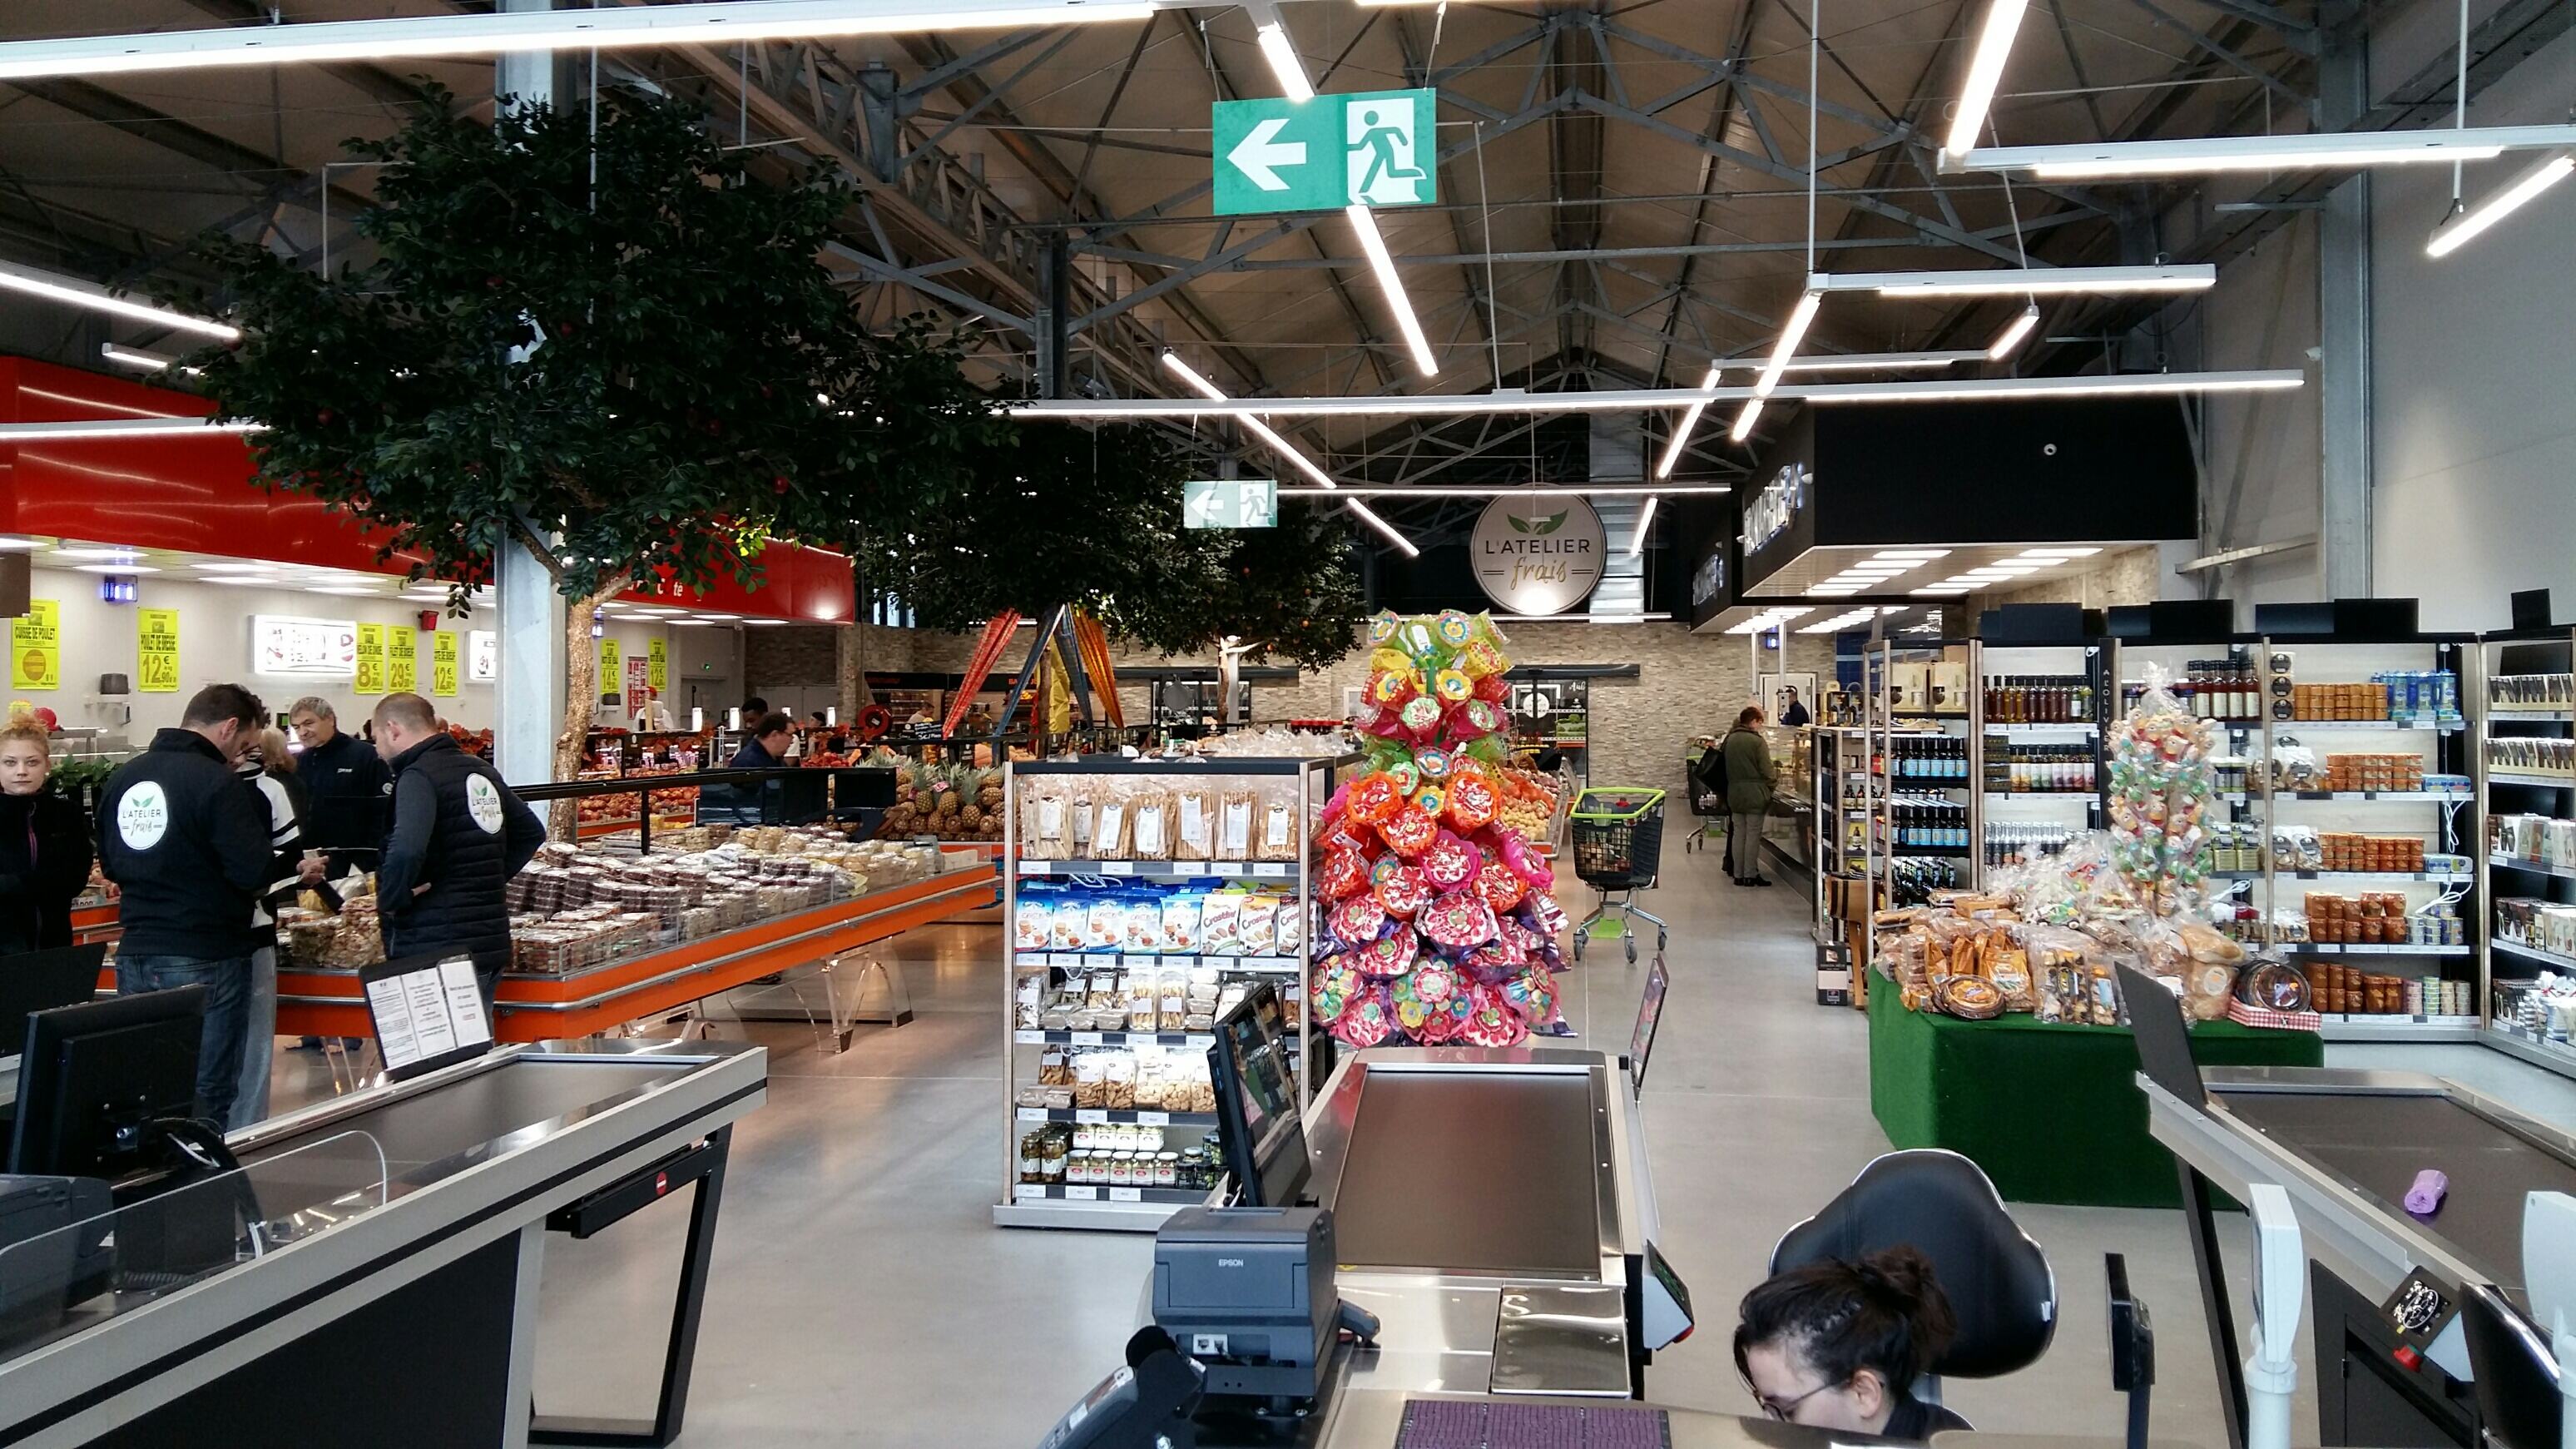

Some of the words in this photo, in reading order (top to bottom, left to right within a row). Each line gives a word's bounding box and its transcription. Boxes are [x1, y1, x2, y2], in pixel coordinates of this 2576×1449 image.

[1485, 538, 1591, 554] L'ATELIER
[1510, 556, 1568, 591] frais
[142, 654, 161, 683] 12
[358, 662, 371, 687] 8
[390, 662, 404, 687] 29
[122, 809, 161, 819] L'ATELIER
[131, 818, 152, 836] frais
[1218, 1258, 1244, 1268] EPSON
